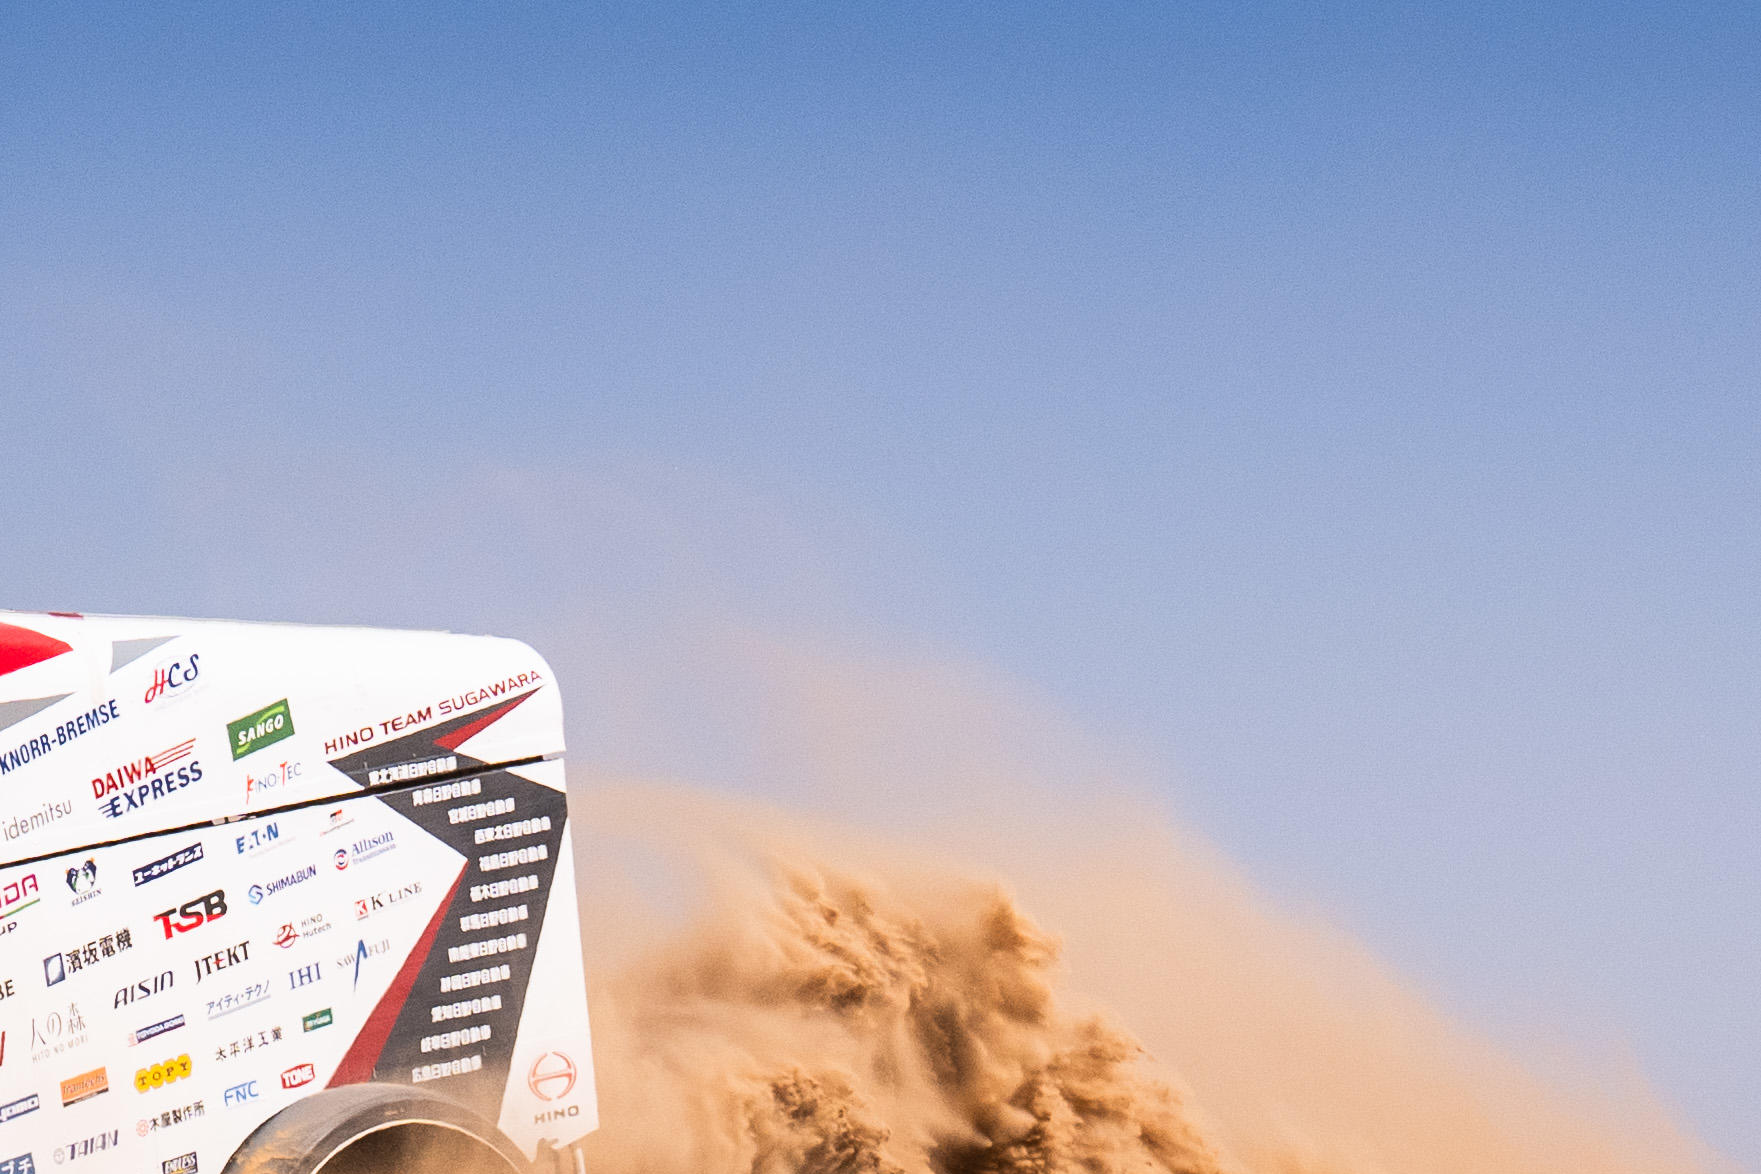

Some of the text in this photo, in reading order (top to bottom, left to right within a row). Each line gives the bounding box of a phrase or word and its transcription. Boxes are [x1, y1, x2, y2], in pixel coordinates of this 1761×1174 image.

[324, 669, 543, 756] HINO TEAM SUGAWARA
[238, 714, 284, 745] SANGO
[91, 755, 158, 800] DAIWA
[102, 761, 203, 819] EXPRESS
[2, 800, 73, 842] idemitsu
[351, 831, 395, 856] Allison
[266, 864, 317, 896] SHIMABUN
[388, 881, 423, 904] LINE
[153, 889, 228, 940] TSB
[194, 940, 250, 985] JTEKT
[288, 962, 322, 990] IHI
[113, 969, 175, 1010] AISIN
[31, 1002, 86, 1048] 人の森
[138, 1061, 189, 1086] TOPY
[282, 1066, 314, 1086] TONE
[223, 1080, 259, 1107] FNC
[534, 1105, 579, 1124] HINO
